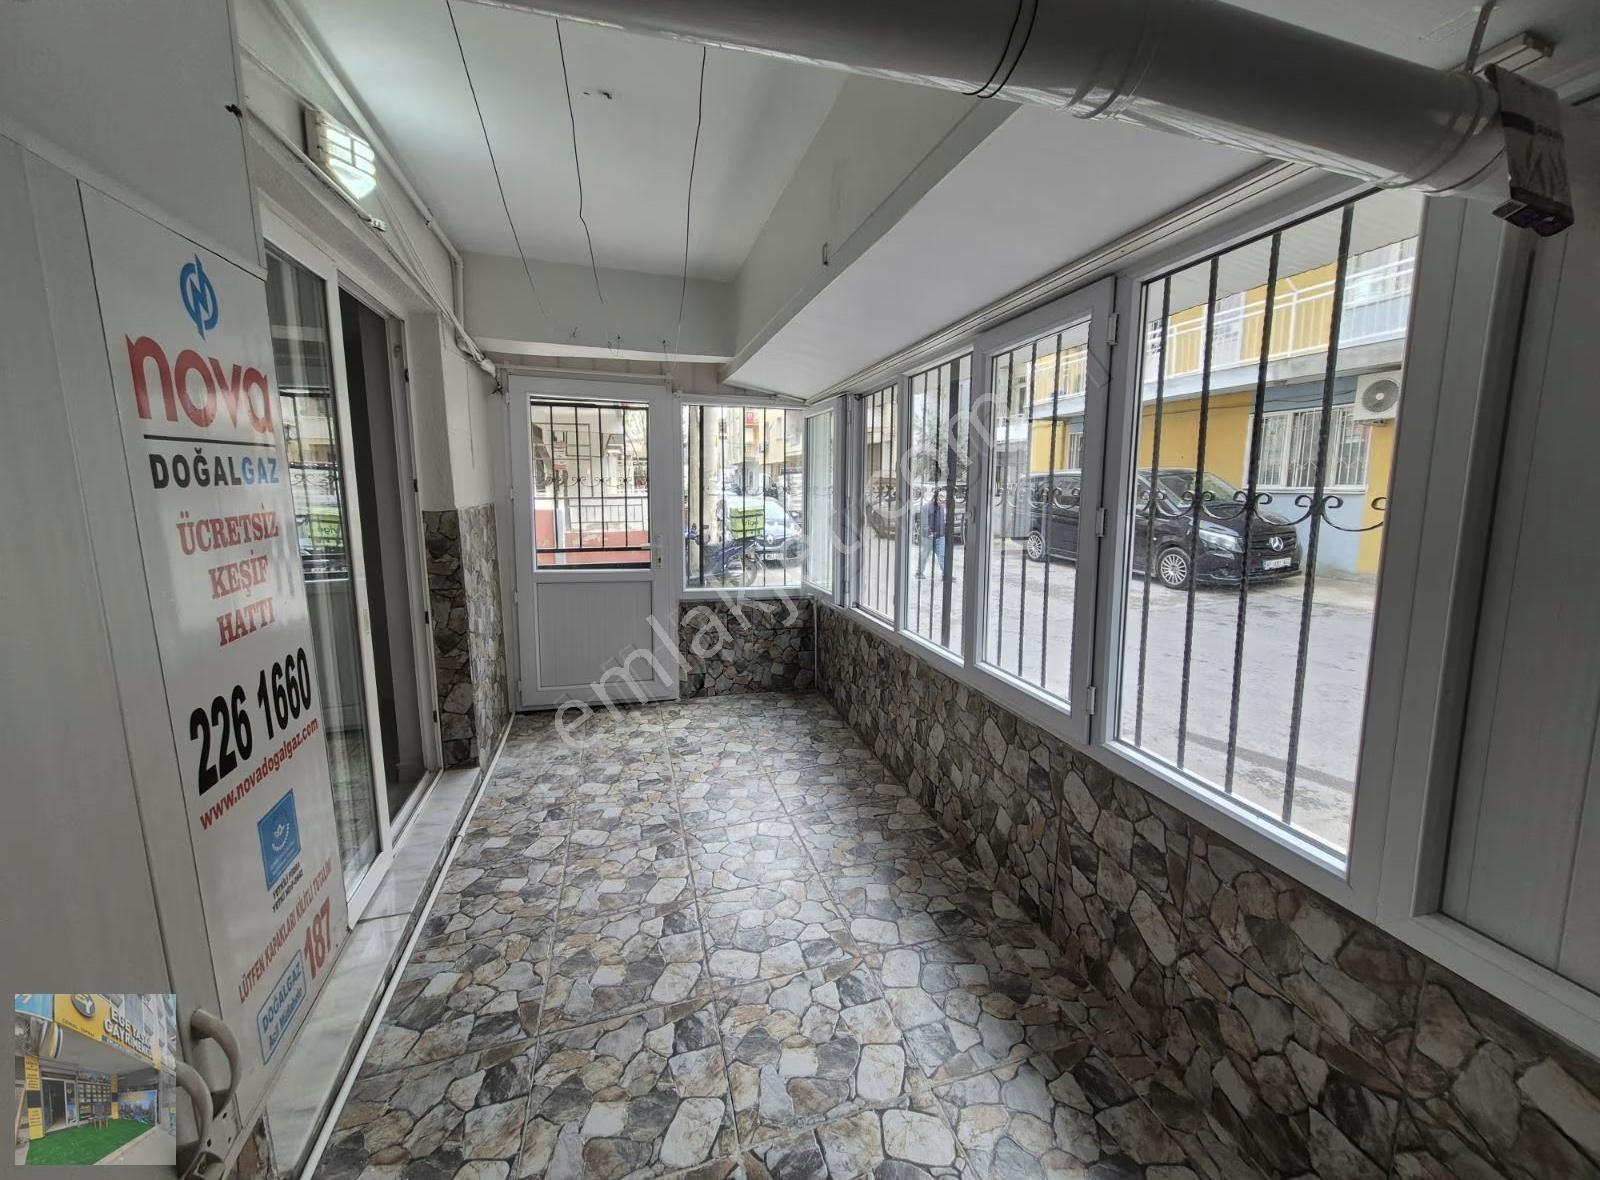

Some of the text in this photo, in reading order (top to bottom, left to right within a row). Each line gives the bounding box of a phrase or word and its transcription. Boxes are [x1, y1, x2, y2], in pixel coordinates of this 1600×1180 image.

[125, 334, 273, 433] nova
[149, 447, 279, 488] DOĞALGAZ
[176, 503, 279, 555] ÜCRETSİZ
[208, 549, 268, 599] KEŞİF
[217, 597, 275, 646] HATTI
[190, 647, 311, 796] 226 1660
[200, 718, 318, 830] www.novadogalgaz.com
[304, 896, 331, 980] 187
[238, 961, 266, 1004] LÜTFEN
